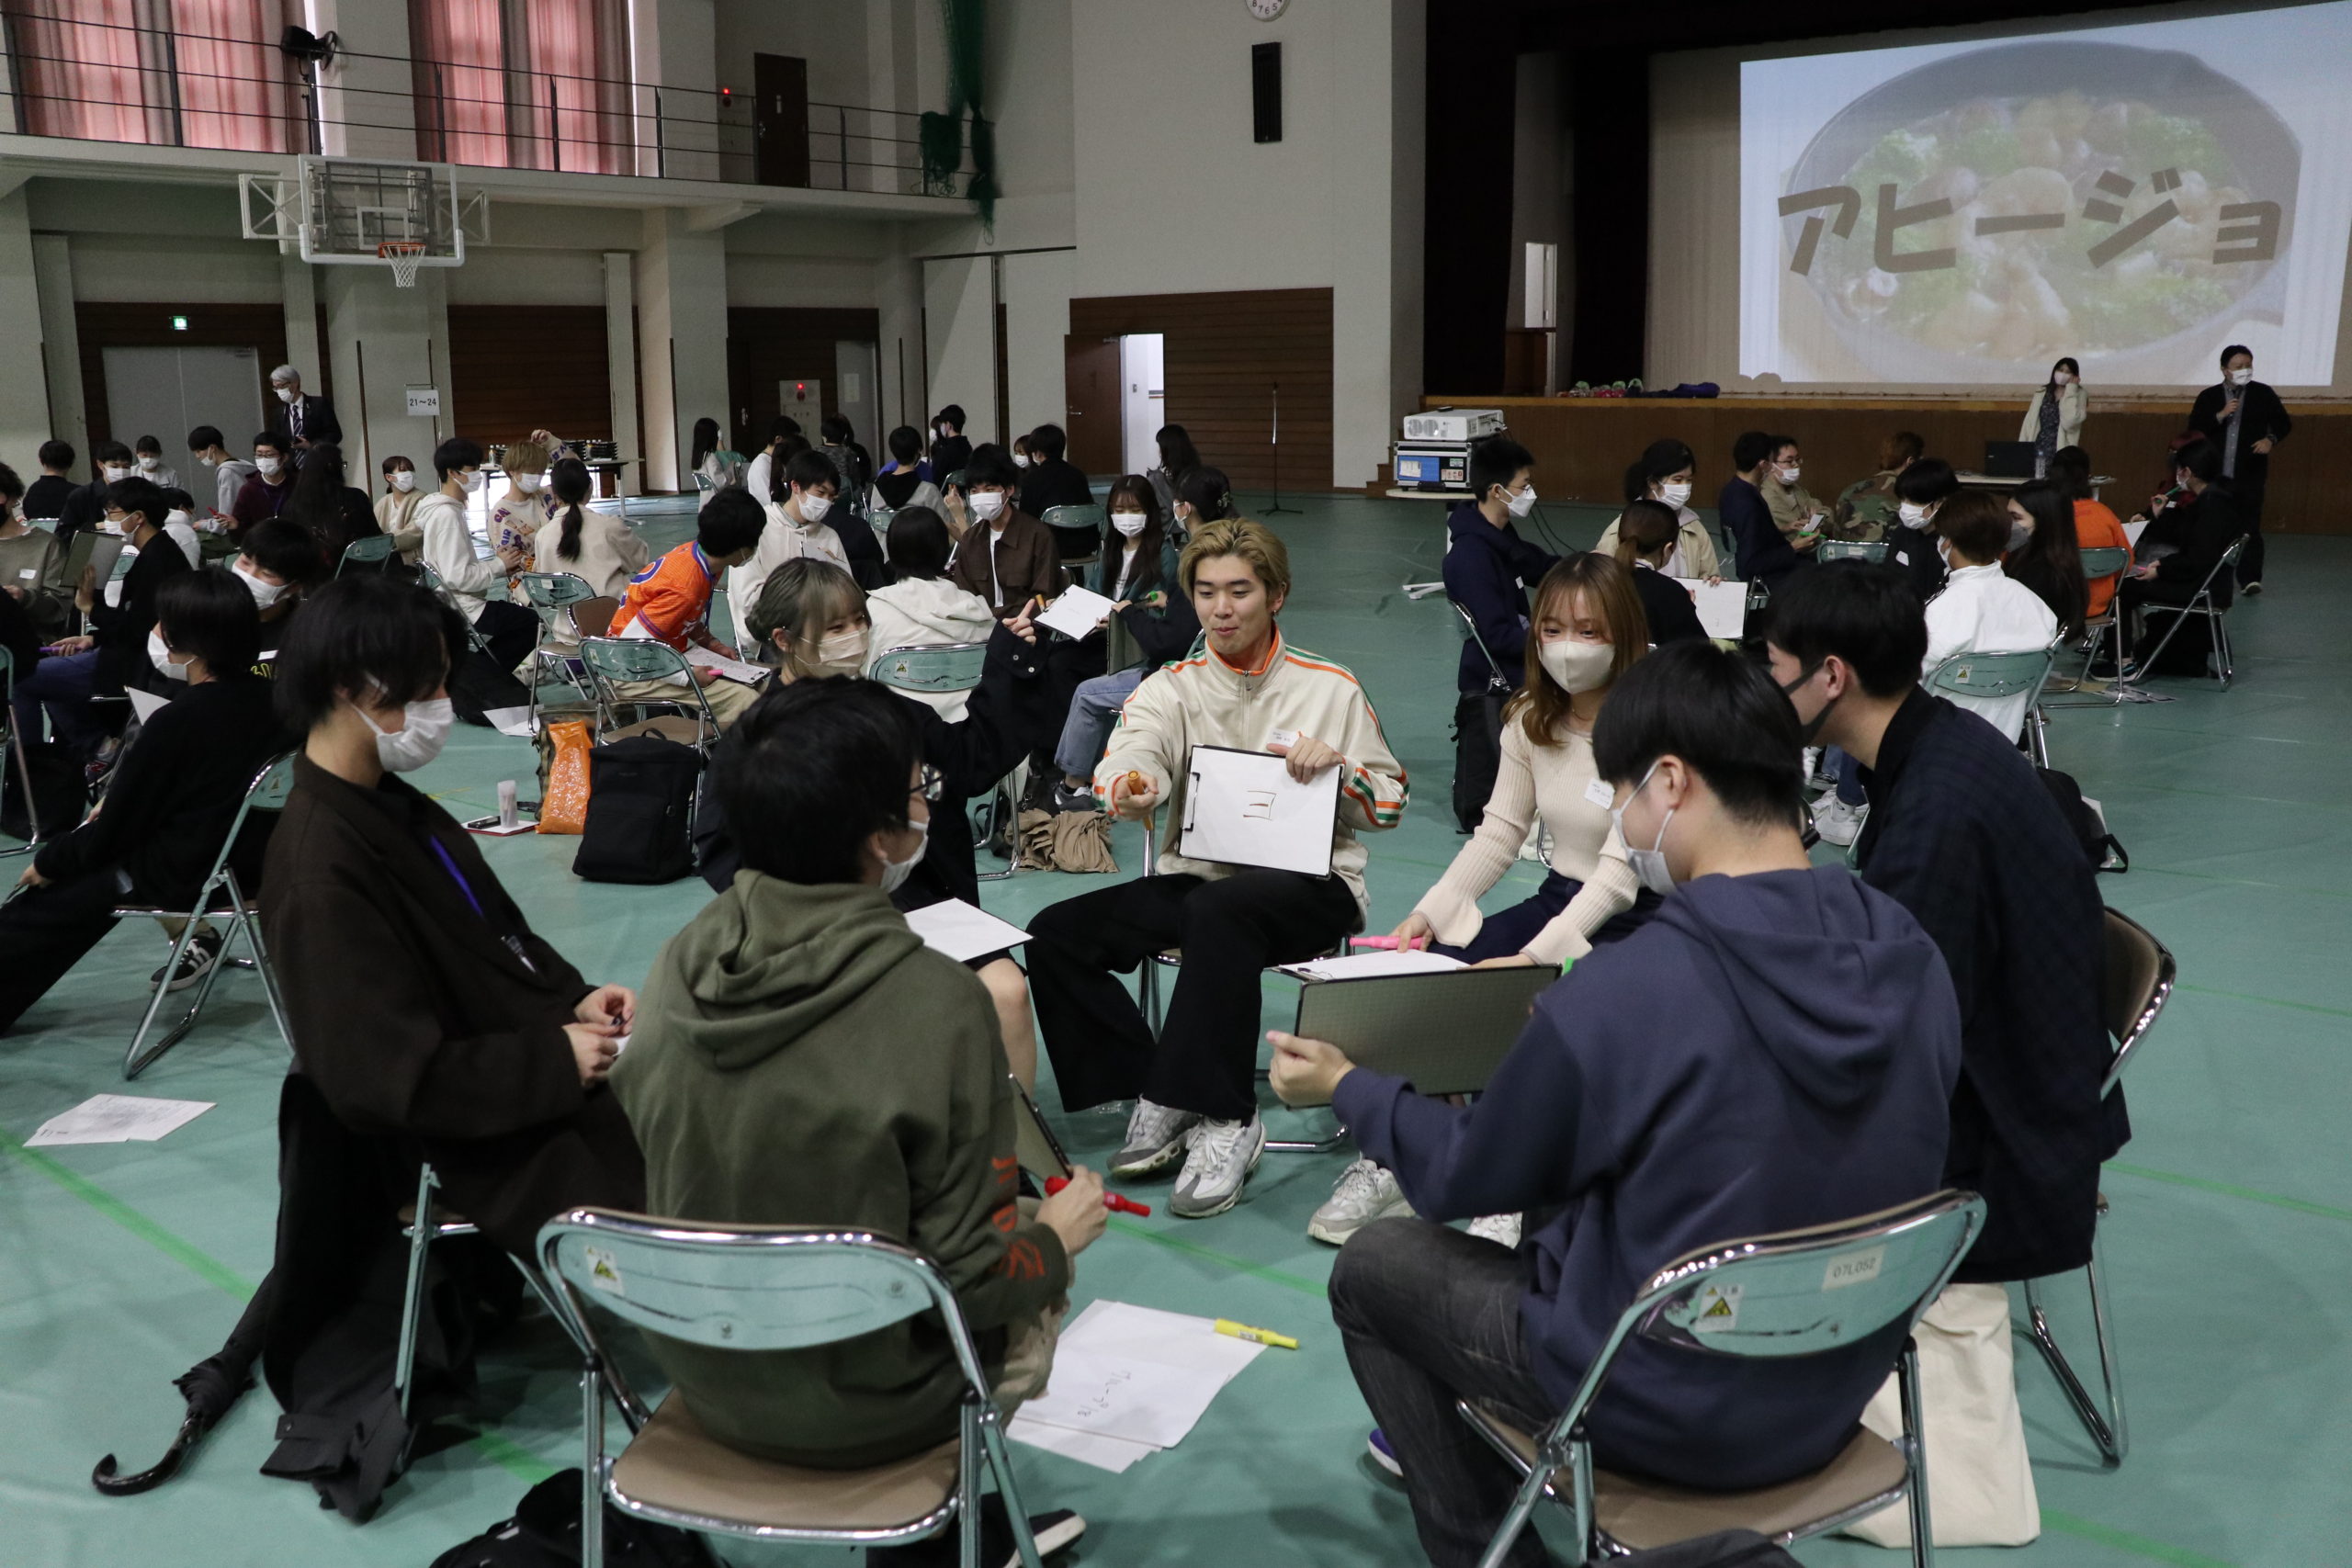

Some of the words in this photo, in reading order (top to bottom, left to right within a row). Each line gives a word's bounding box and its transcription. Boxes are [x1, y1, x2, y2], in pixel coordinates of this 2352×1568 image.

[1778, 167, 2282, 276] アヒージョ
